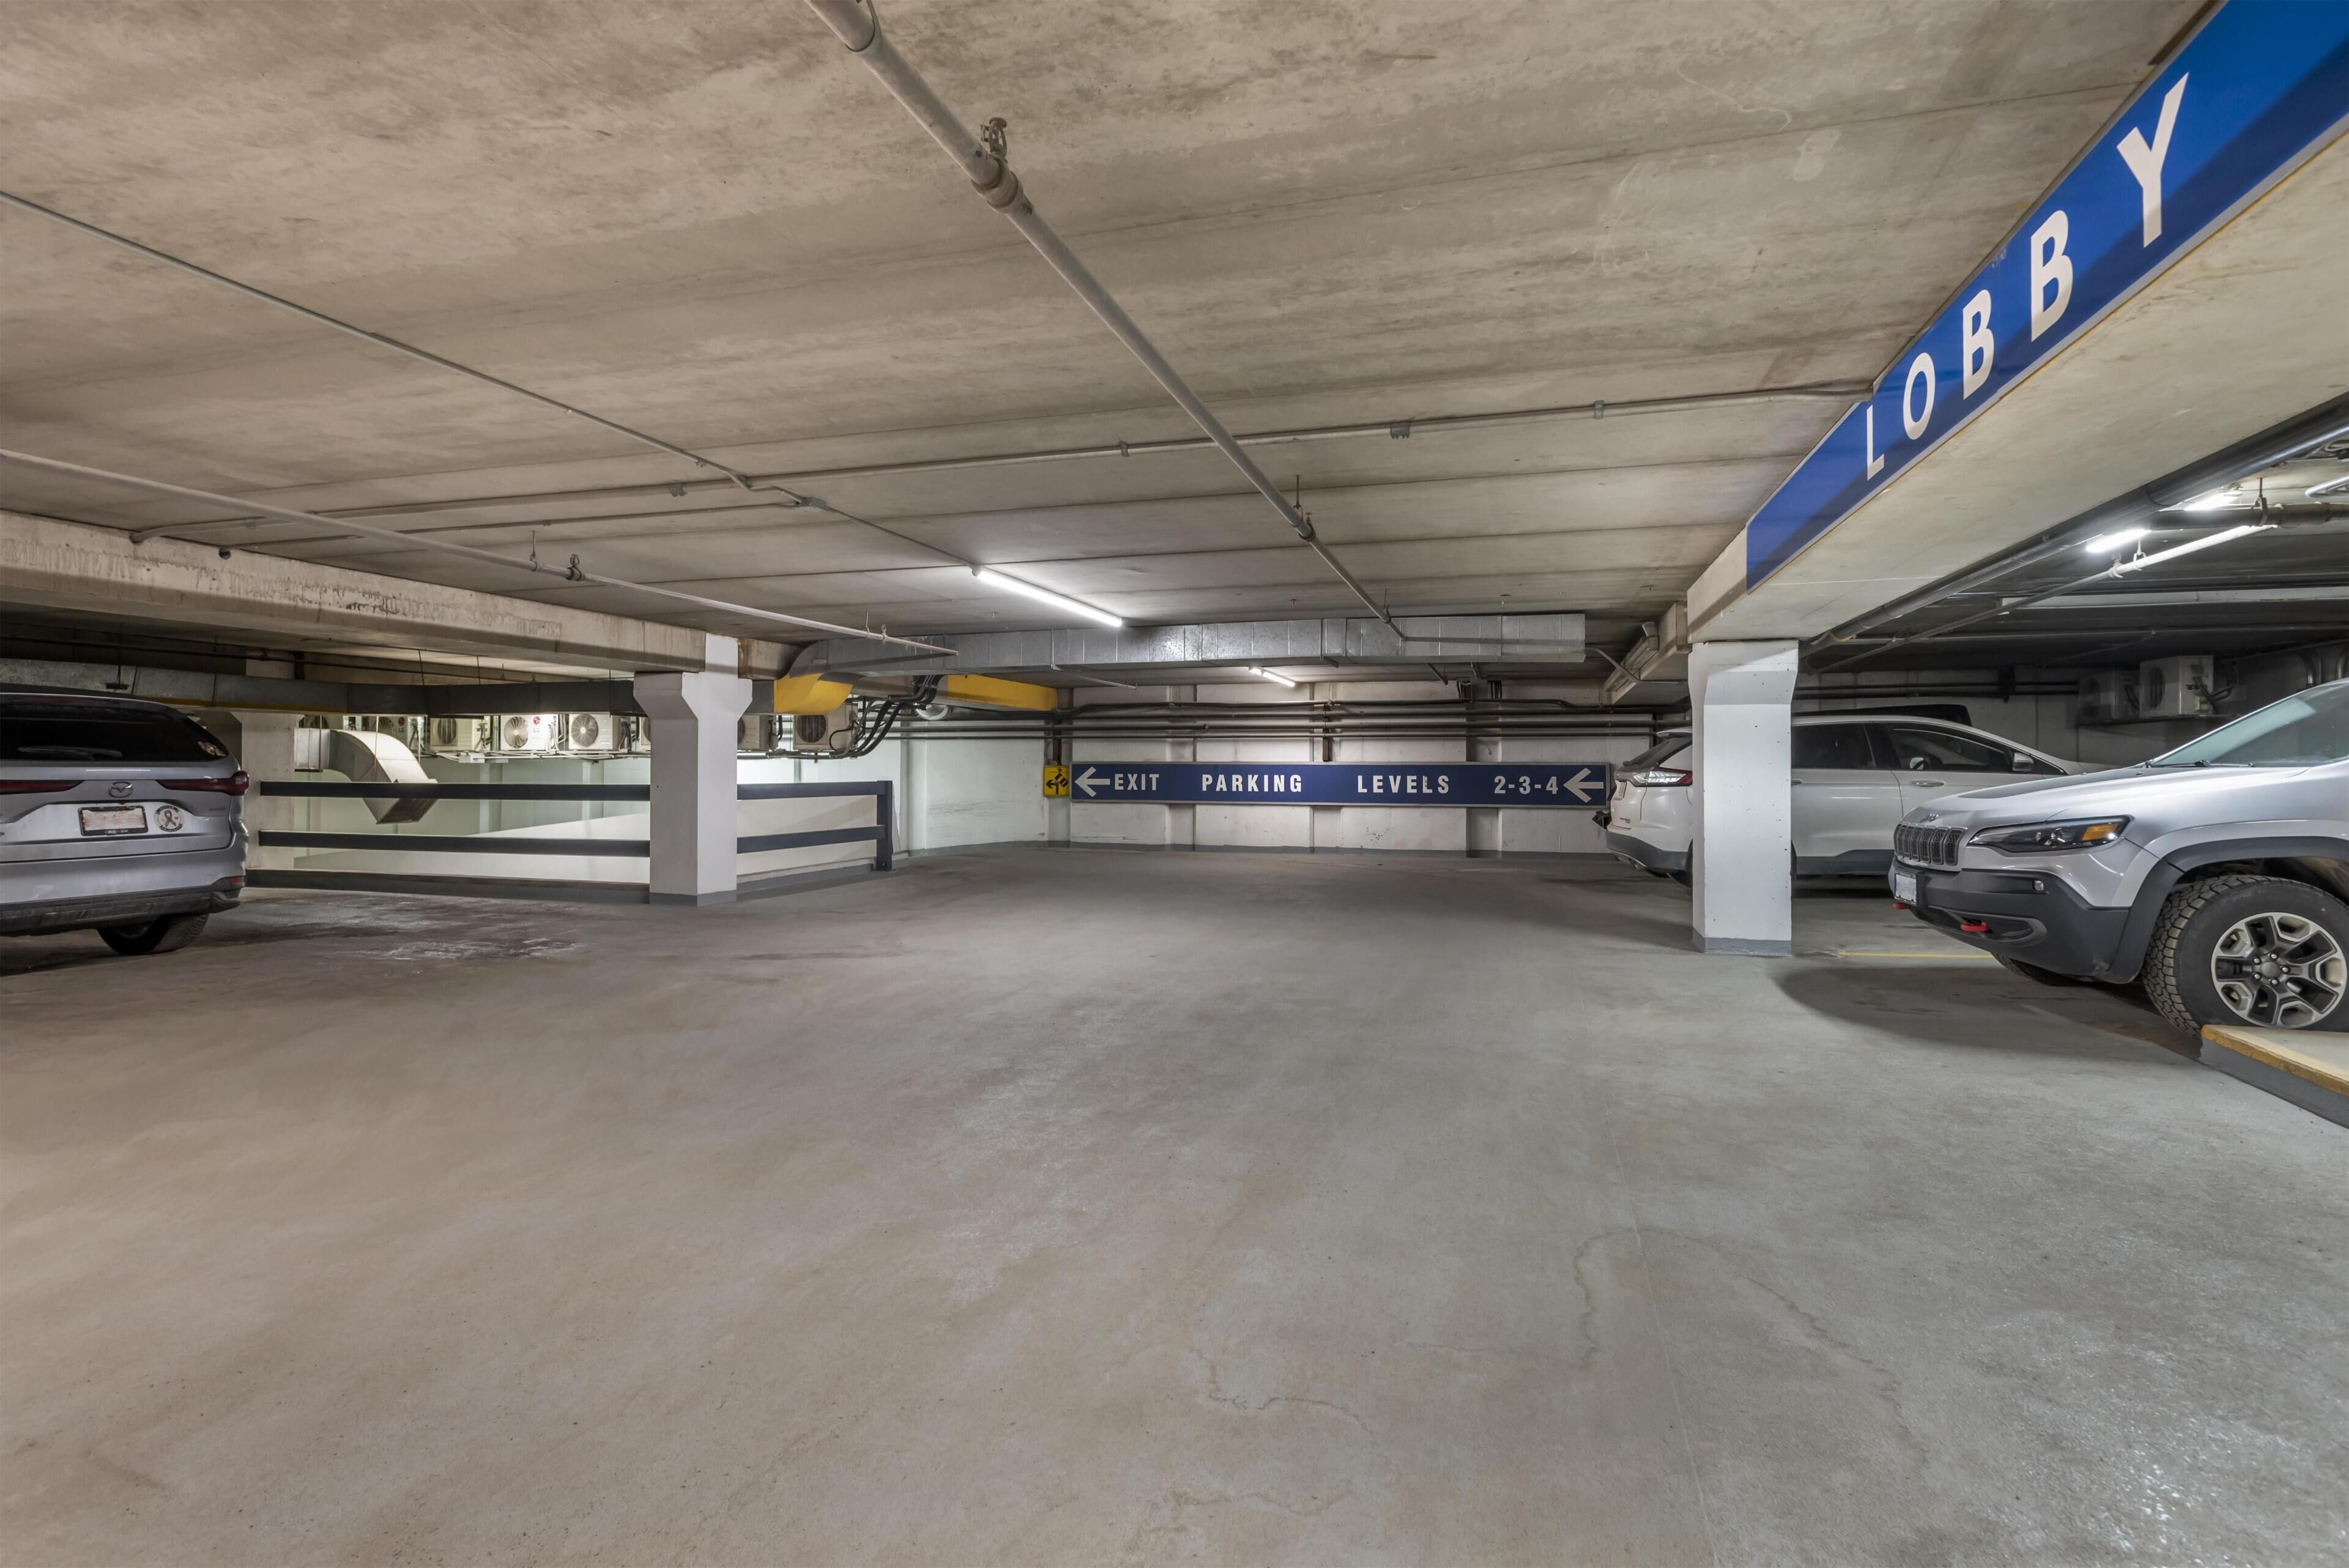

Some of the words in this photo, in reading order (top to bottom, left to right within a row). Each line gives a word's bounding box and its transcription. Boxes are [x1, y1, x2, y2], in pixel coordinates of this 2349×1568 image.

[1866, 72, 2189, 481] LOBBY
[1115, 774, 1159, 790] EXIT
[1202, 774, 1302, 793] PARKING
[1357, 775, 1450, 793] LEVELS
[1494, 776, 1559, 794] 2-3-4
